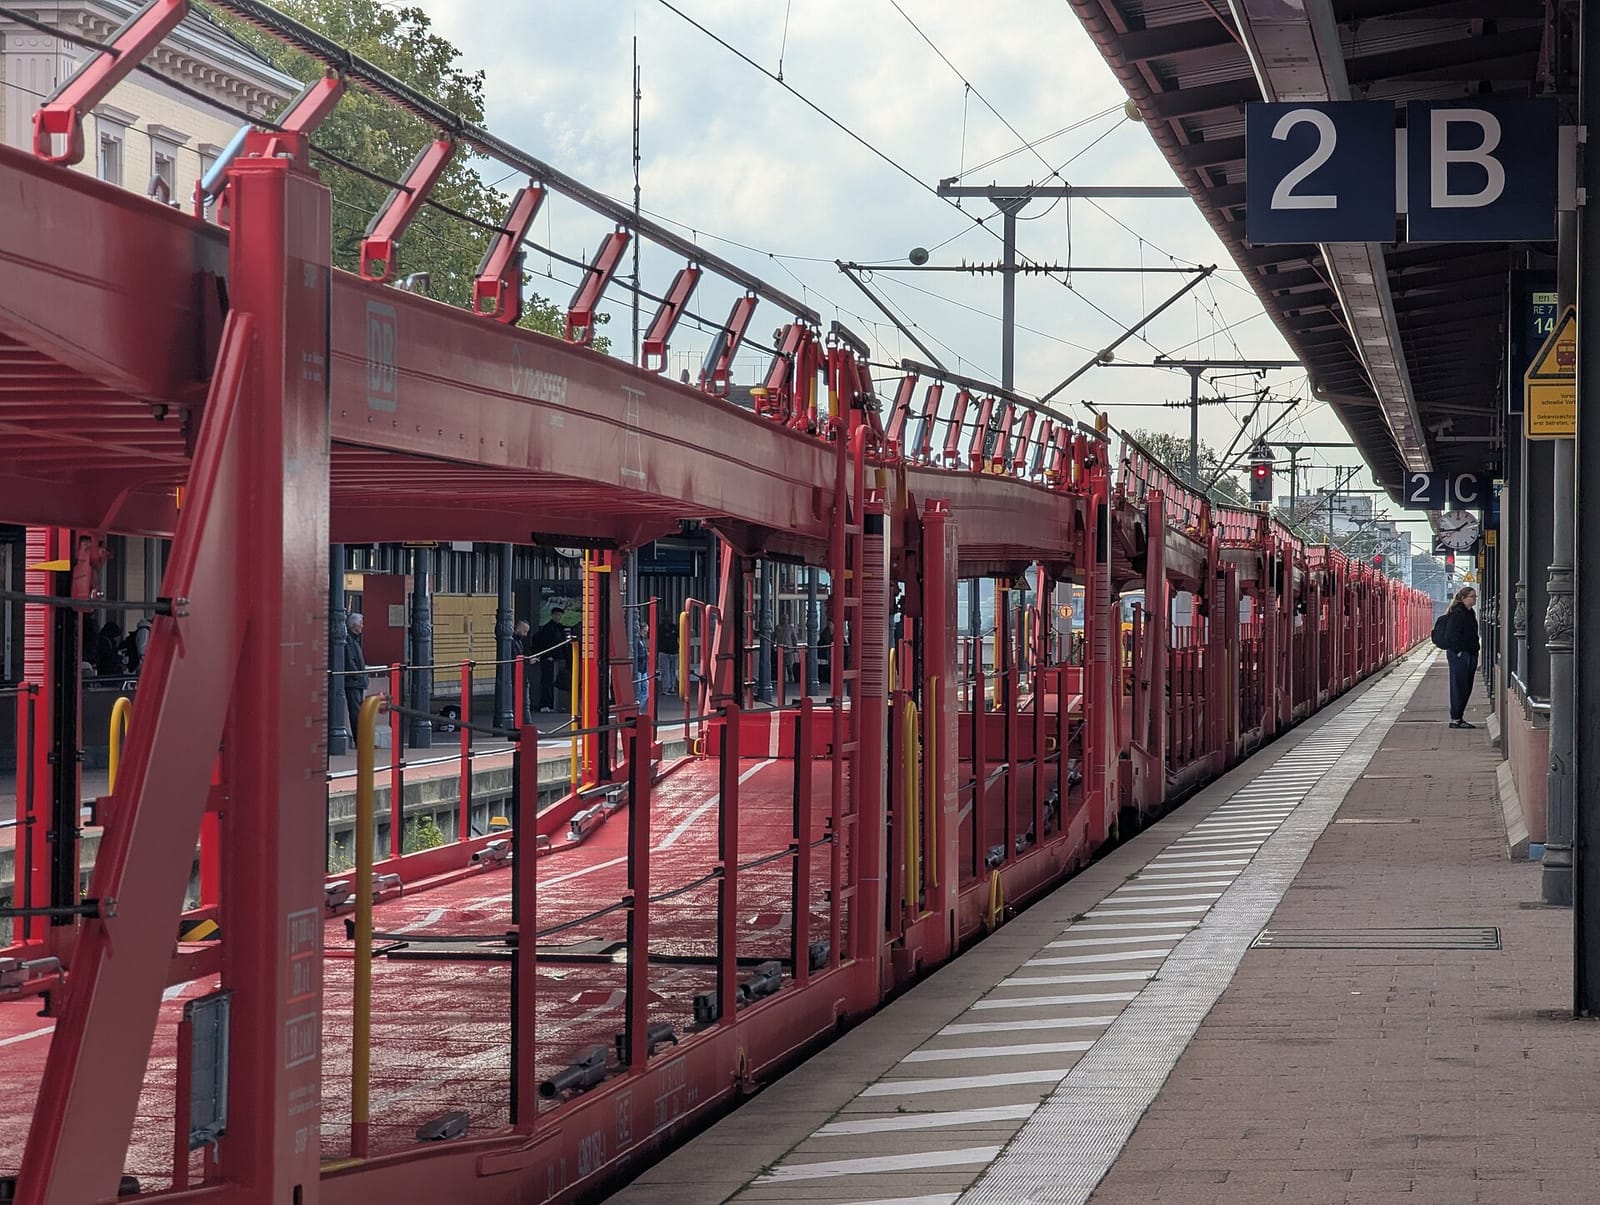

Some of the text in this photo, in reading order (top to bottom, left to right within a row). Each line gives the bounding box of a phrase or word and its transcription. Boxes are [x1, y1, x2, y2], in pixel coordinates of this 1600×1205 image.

[1270, 108, 1506, 210] 2 B
[1533, 305, 1554, 315] RE 7
[1533, 317, 1555, 335] 14
[369, 317, 397, 397] DB
[1410, 473, 1478, 503] 2 C
